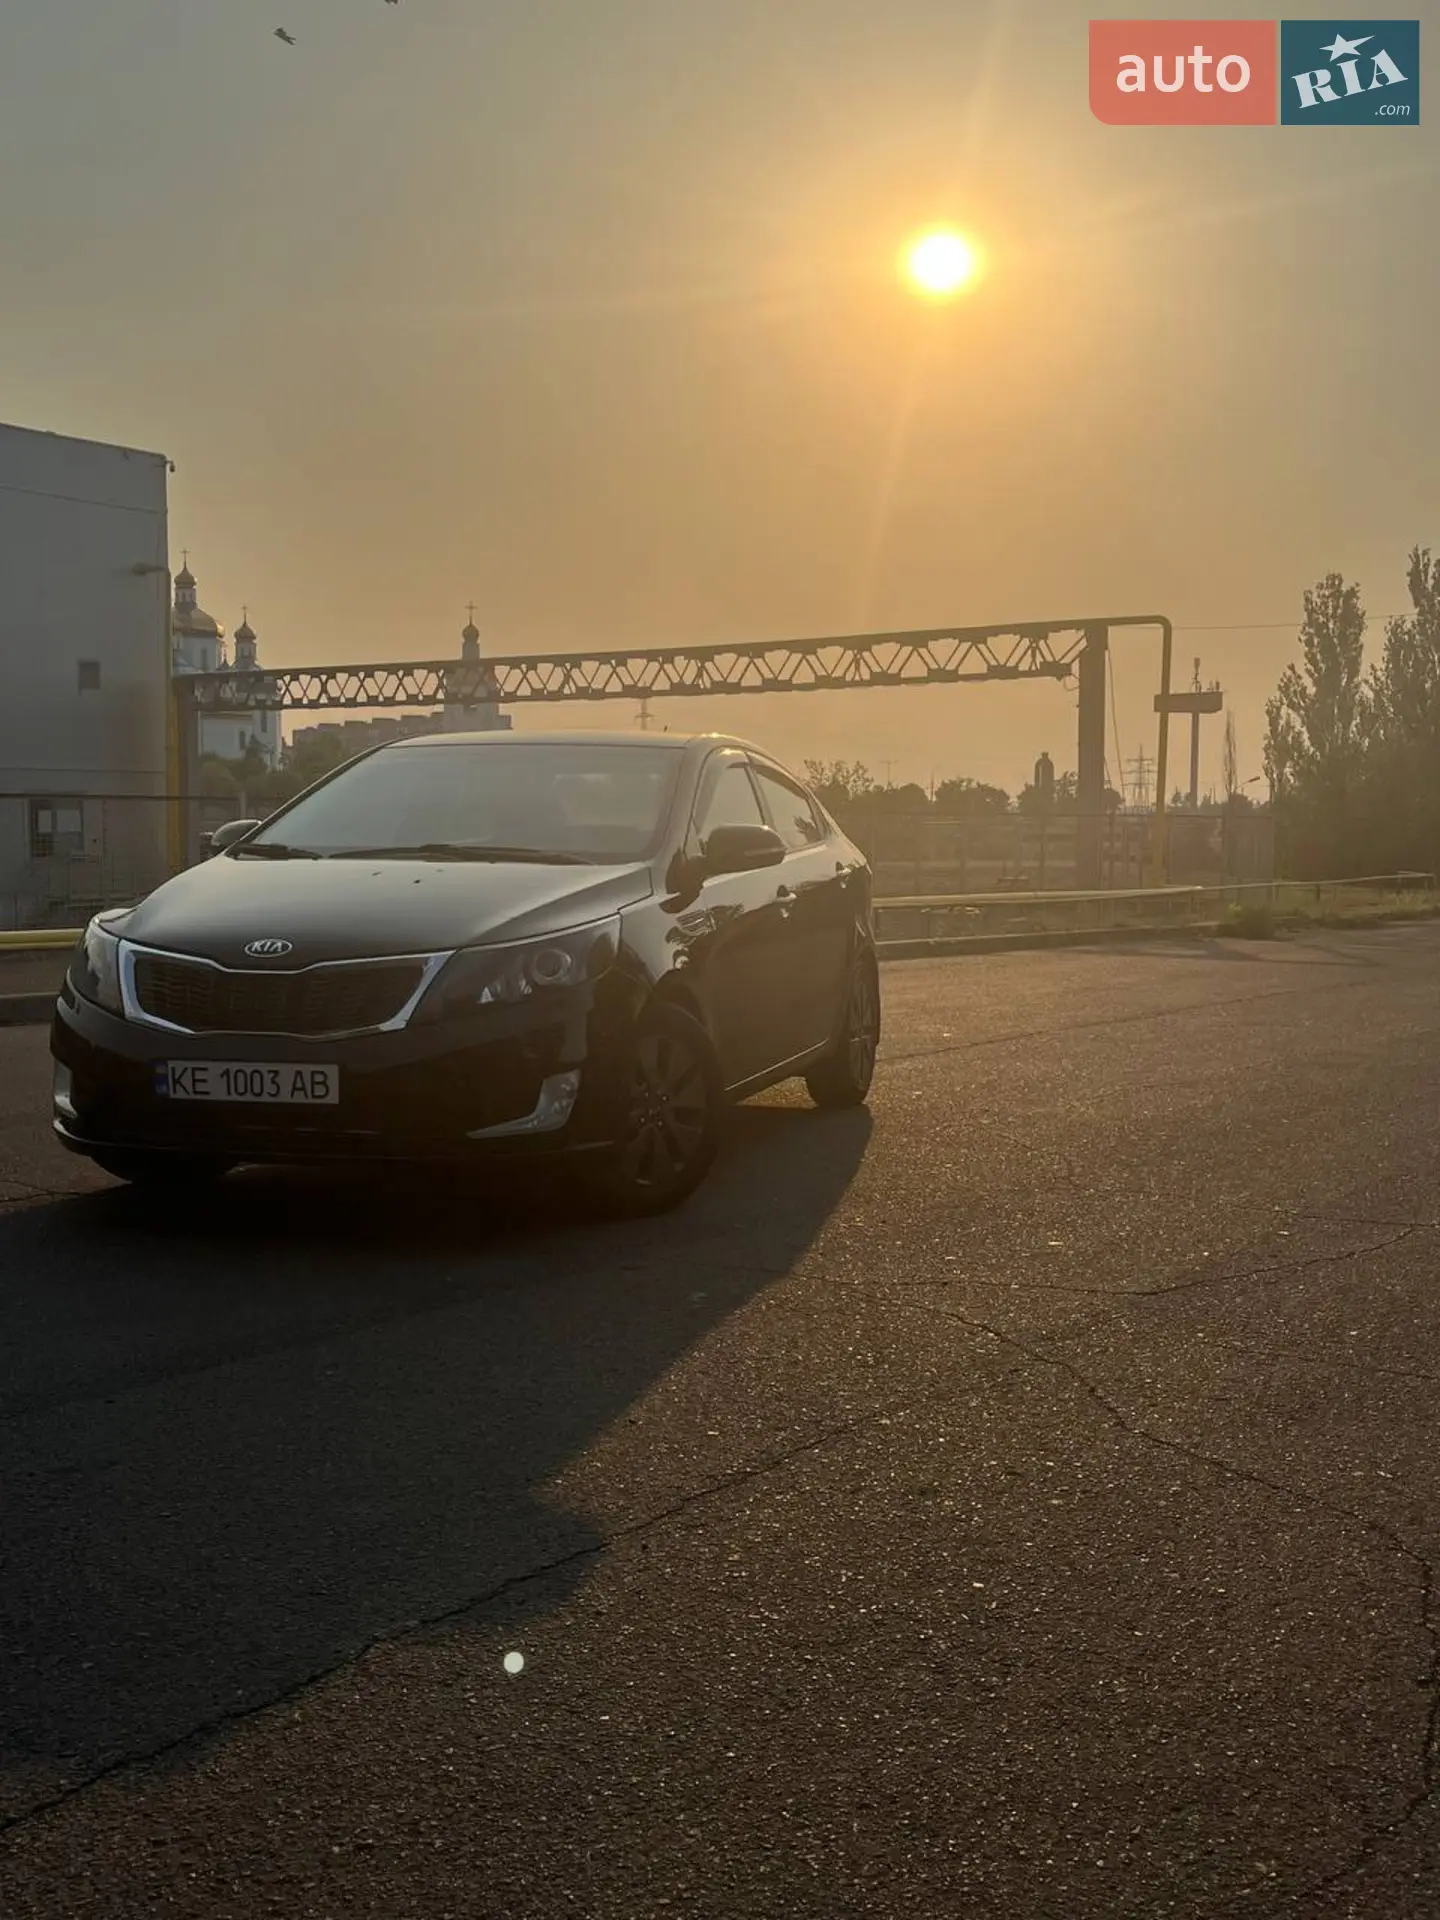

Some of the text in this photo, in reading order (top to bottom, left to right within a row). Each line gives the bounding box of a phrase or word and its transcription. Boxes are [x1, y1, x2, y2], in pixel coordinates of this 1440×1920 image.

[251, 941, 282, 952] KIA
[170, 1066, 330, 1100] KE 1003 AB
